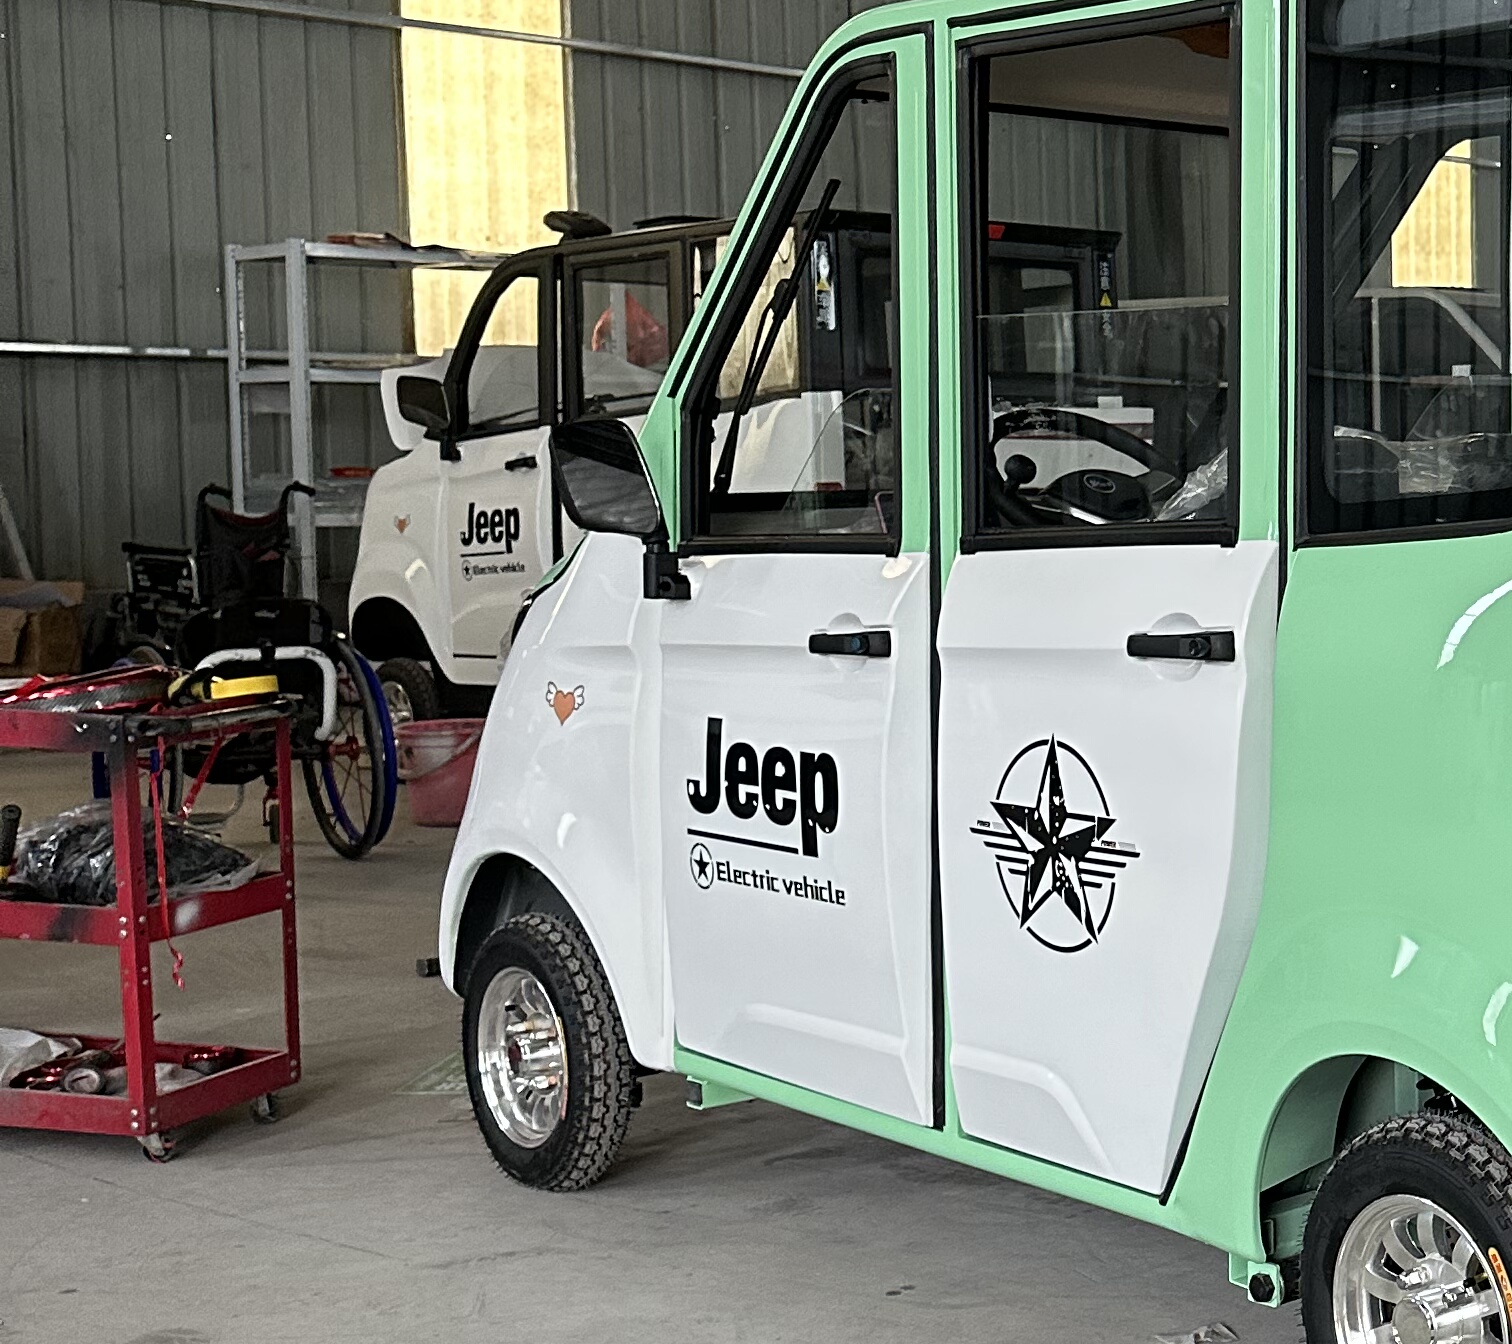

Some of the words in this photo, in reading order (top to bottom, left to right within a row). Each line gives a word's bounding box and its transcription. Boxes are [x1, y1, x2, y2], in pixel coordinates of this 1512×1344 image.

[460, 502, 520, 554] Jeep
[686, 716, 839, 858] Jeep
[715, 860, 781, 894] Electric
[782, 874, 847, 907] vehicle
